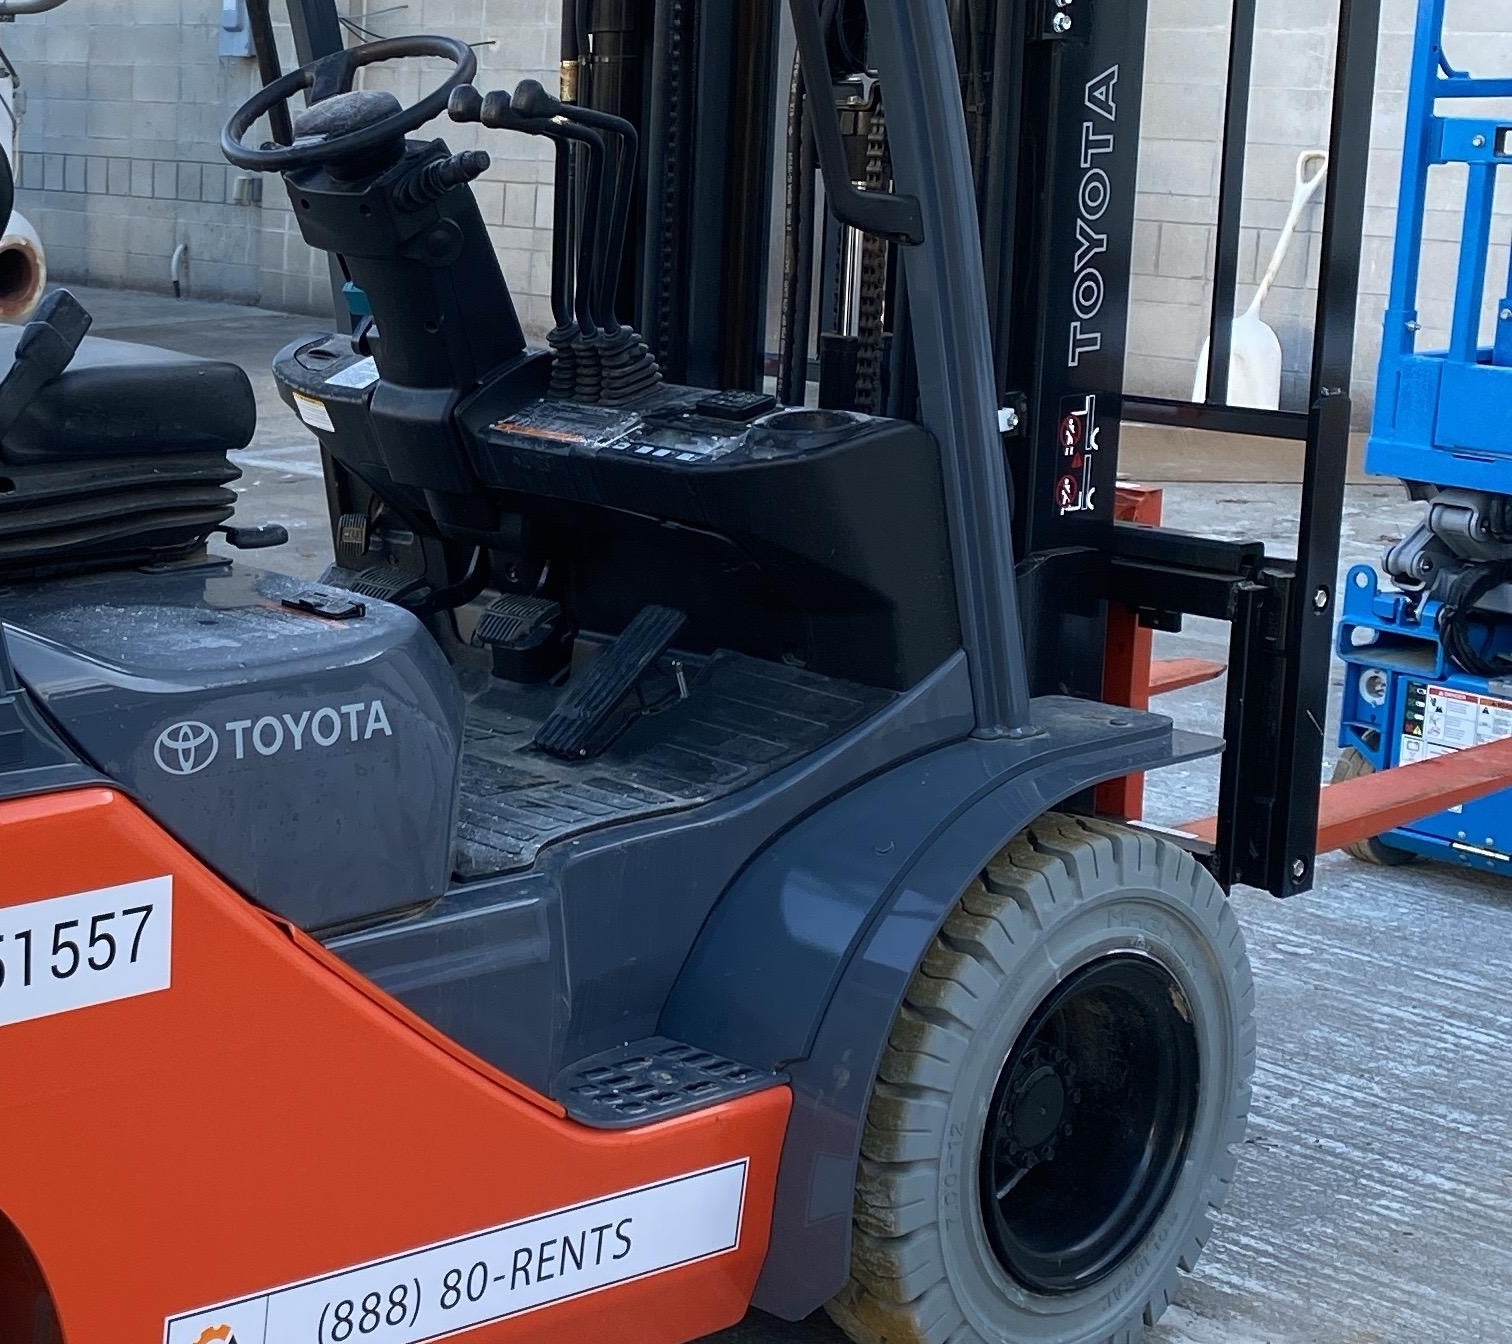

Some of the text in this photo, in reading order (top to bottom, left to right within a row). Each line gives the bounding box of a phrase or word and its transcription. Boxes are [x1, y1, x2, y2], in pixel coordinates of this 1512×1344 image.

[1068, 64, 1119, 367] TOYOTA
[225, 699, 393, 761] TOYOTA
[439, 1216, 635, 1311] 80-RENTS
